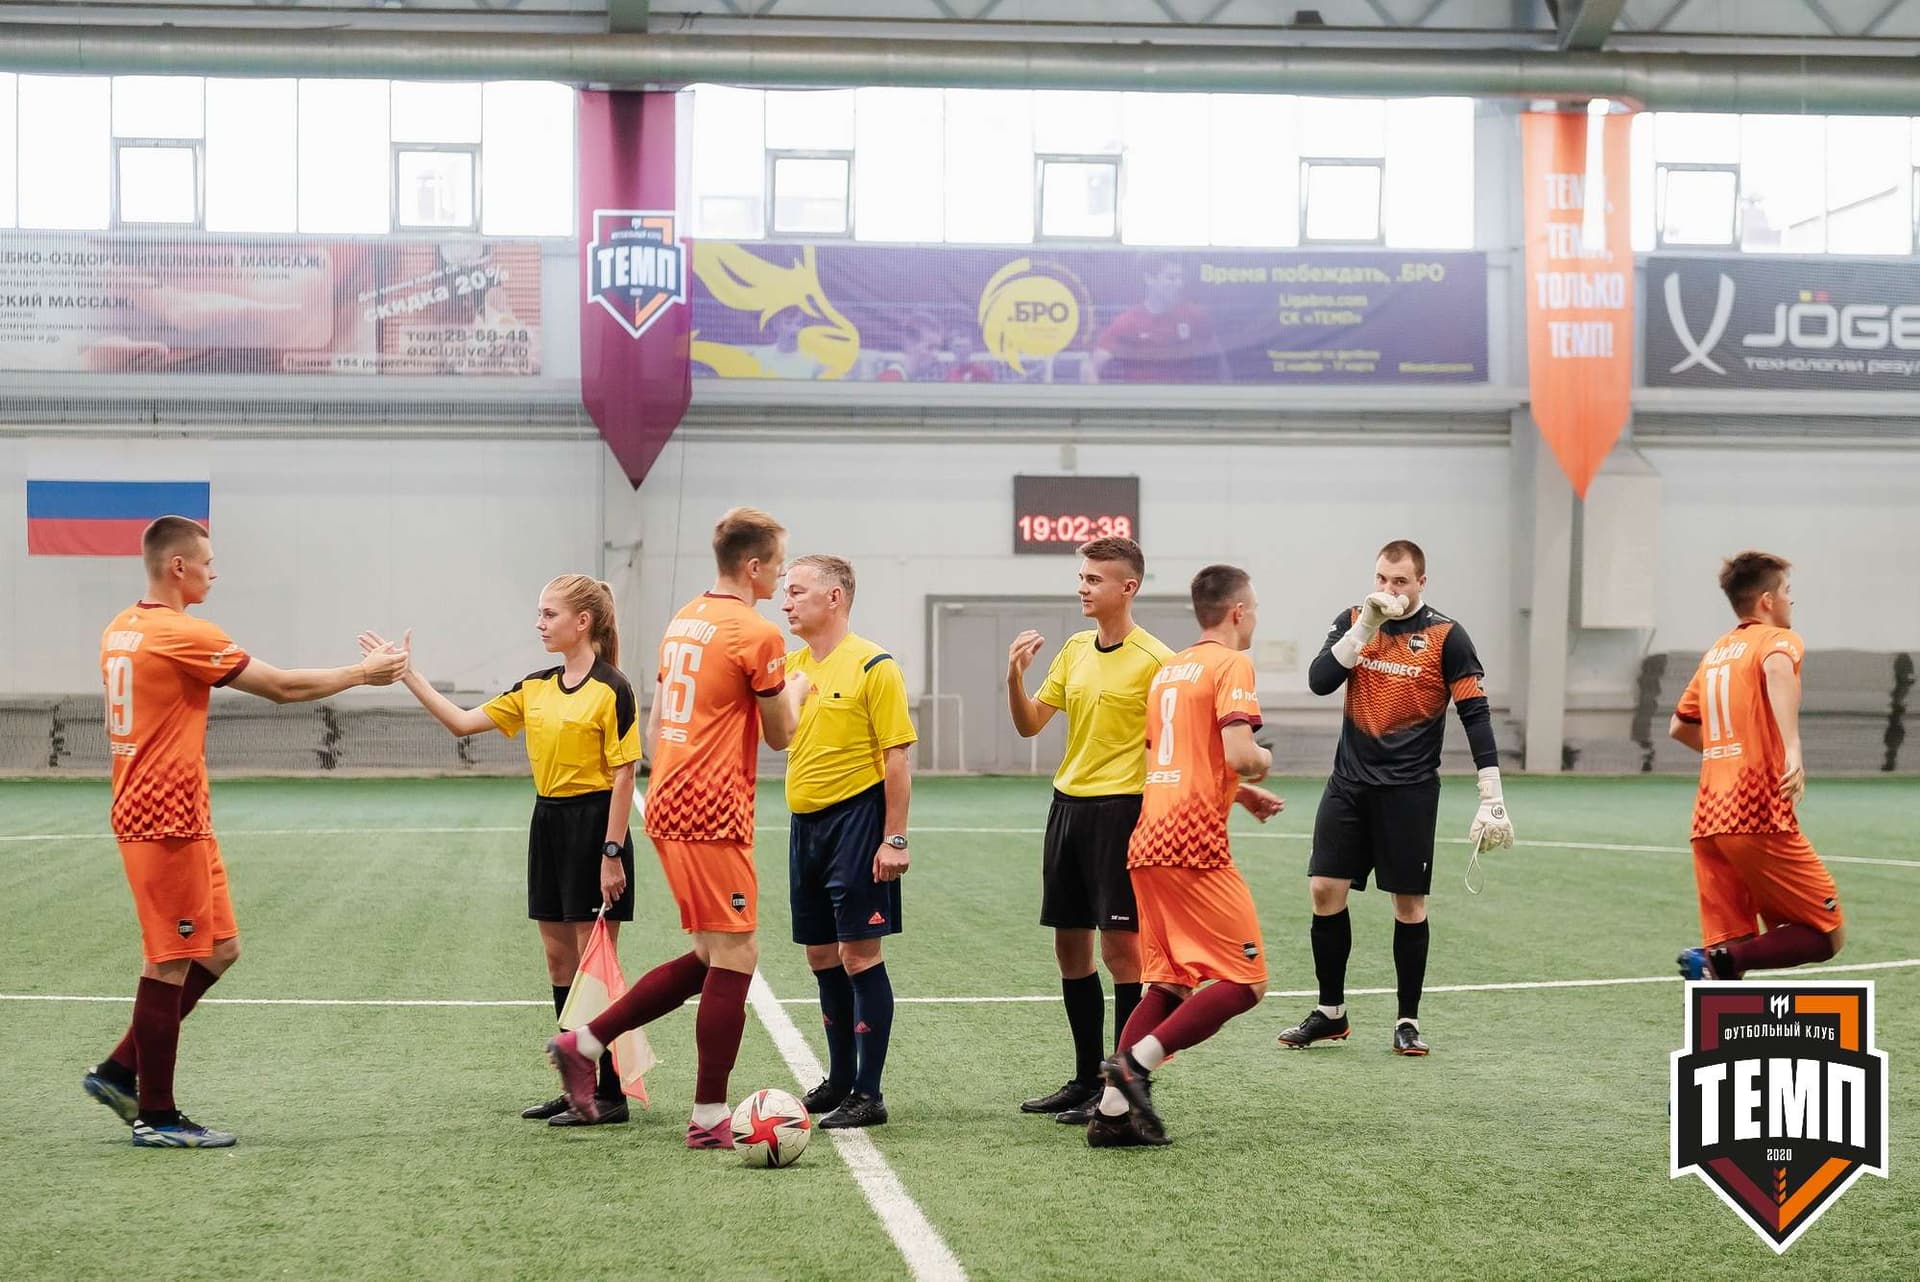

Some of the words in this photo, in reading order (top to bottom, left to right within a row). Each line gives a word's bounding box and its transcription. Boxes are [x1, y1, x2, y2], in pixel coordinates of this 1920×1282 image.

[455, 263, 509, 296] 20%
[597, 245, 676, 290] ТЕМП
[1535, 271, 1625, 309] ТОЛЬКО
[1548, 320, 1614, 358] ТЕМП!
[1018, 515, 1131, 541] 19:02:38
[106, 656, 132, 736] 19
[1706, 664, 1734, 741] 11
[1158, 687, 1178, 766] 8
